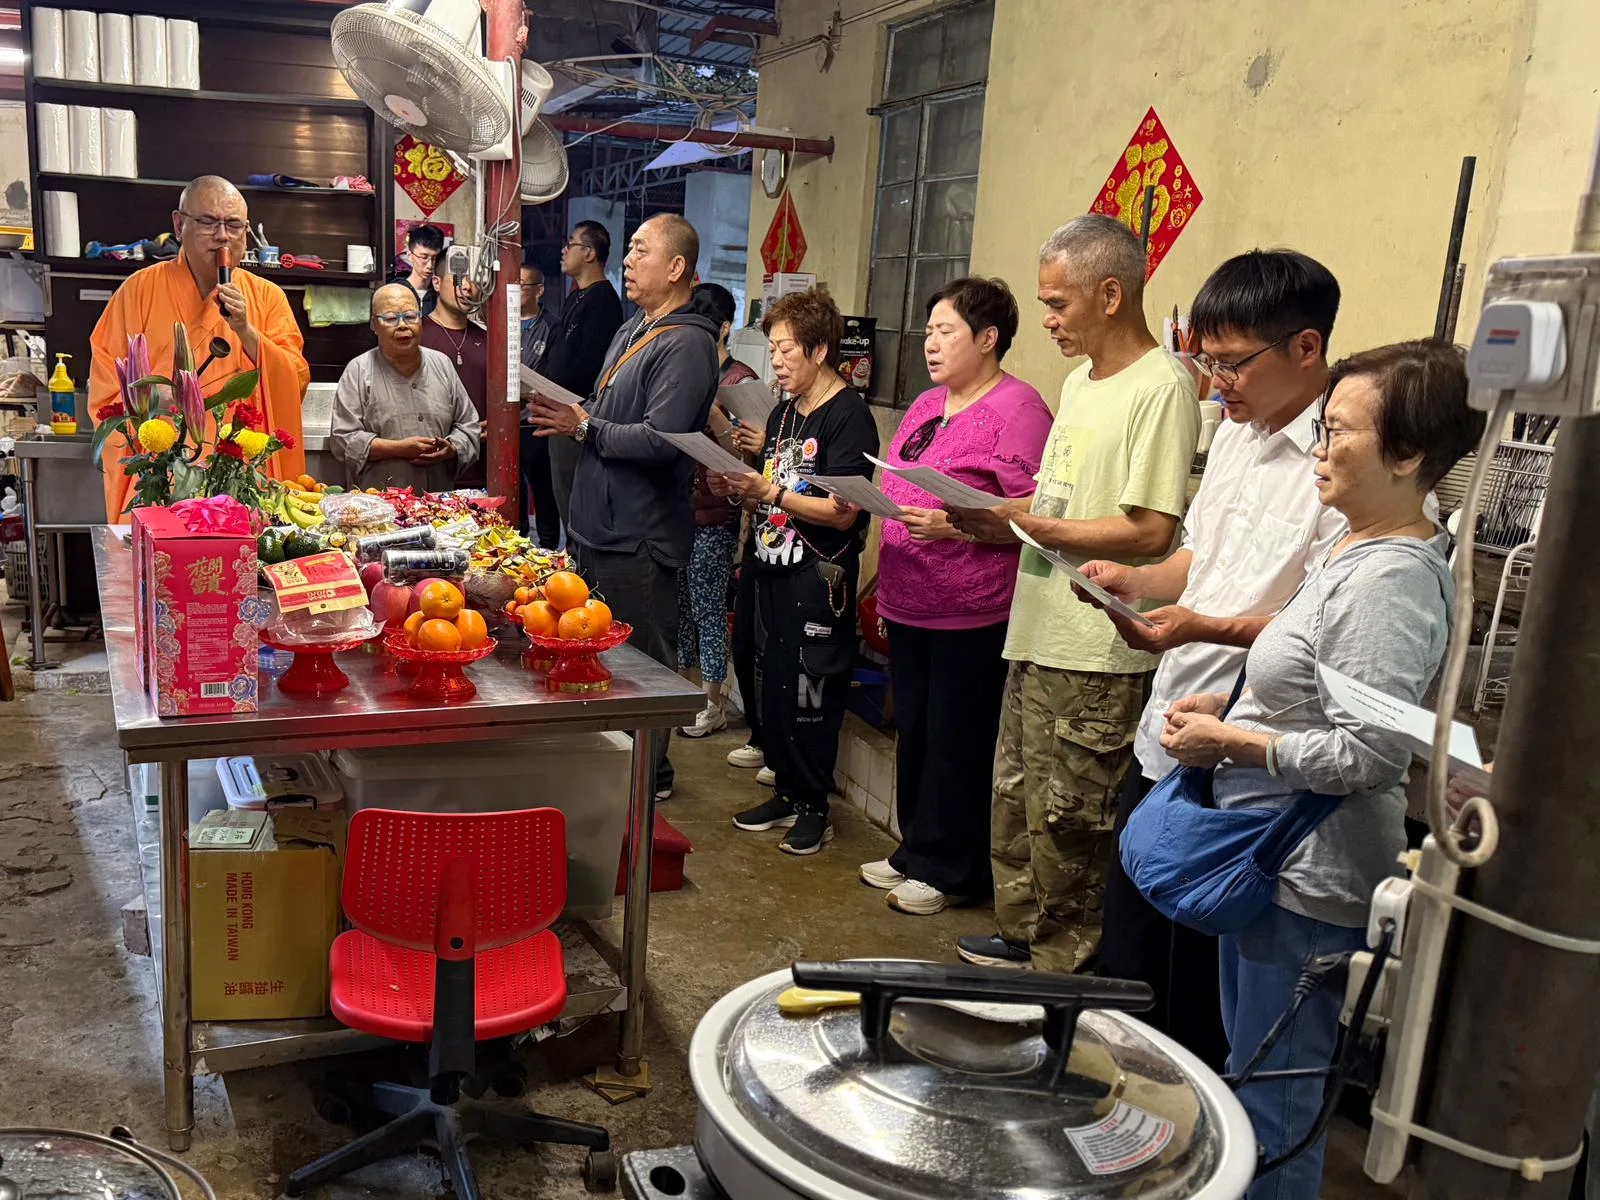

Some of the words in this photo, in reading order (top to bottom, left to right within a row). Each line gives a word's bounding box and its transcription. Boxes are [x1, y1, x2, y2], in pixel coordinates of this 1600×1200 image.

[1115, 138, 1170, 236] 福
[226, 872, 238, 903] MADE
[241, 871, 253, 900] HONG
[226, 907, 238, 919] IN
[242, 903, 254, 929] KONG
[227, 923, 239, 961] TAIWAN
